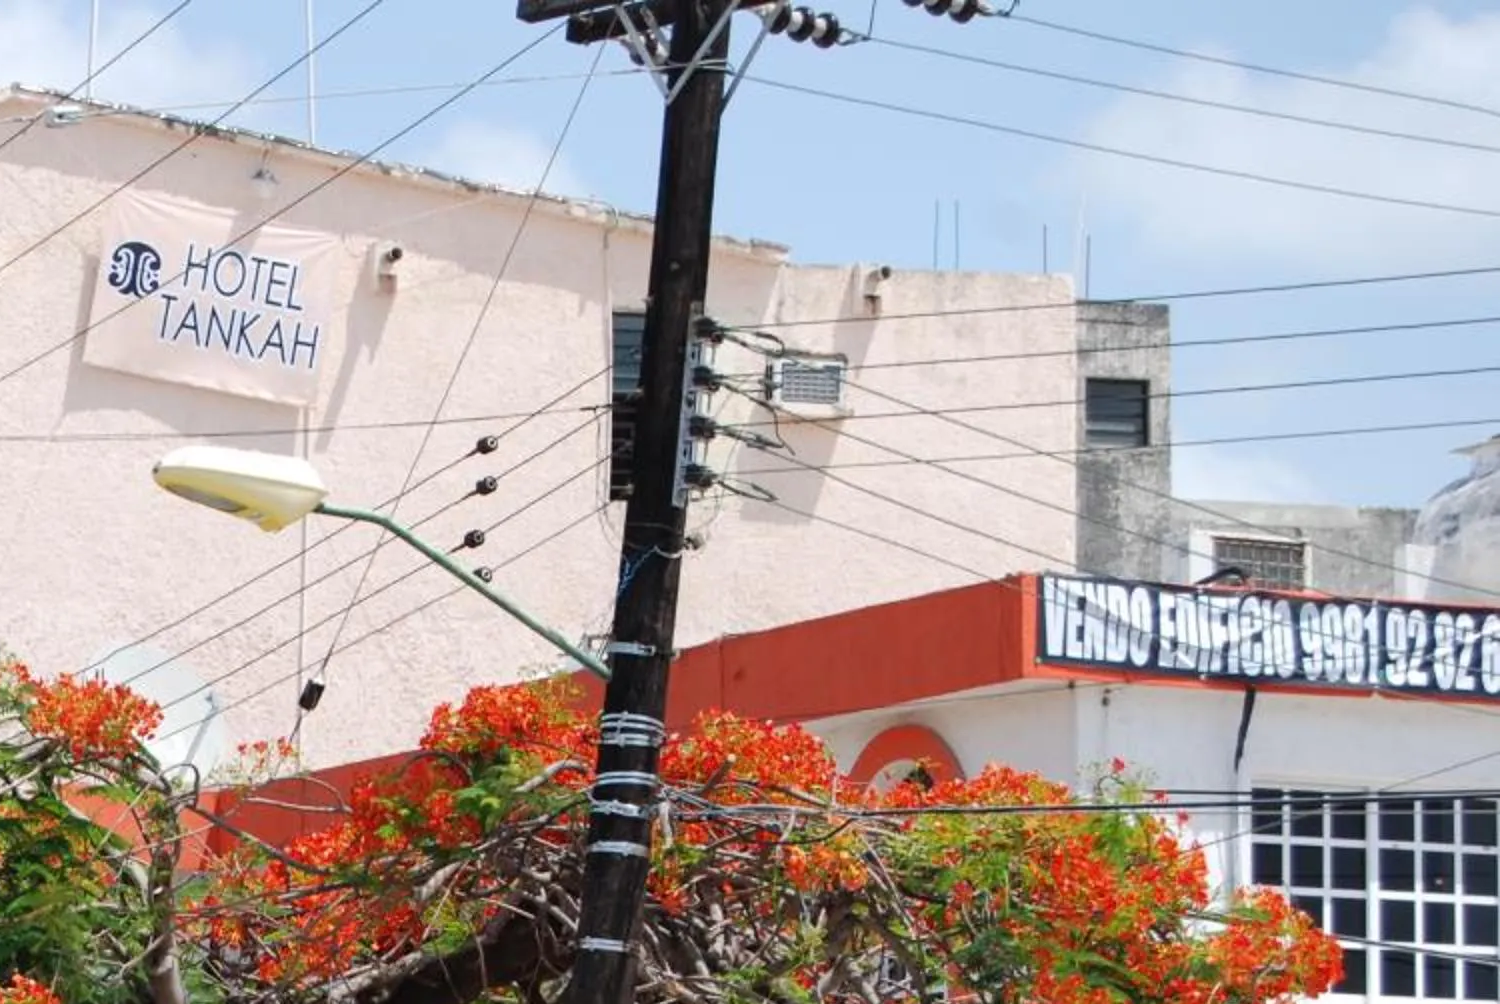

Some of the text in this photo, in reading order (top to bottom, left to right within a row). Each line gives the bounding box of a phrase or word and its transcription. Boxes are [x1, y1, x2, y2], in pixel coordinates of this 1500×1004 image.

[184, 244, 303, 311] HOTEL
[160, 294, 319, 369] TANKAH
[1043, 576, 1152, 667] VENDO
[1157, 591, 1296, 679] EDIFICIO
[1301, 602, 1380, 684] 9981
